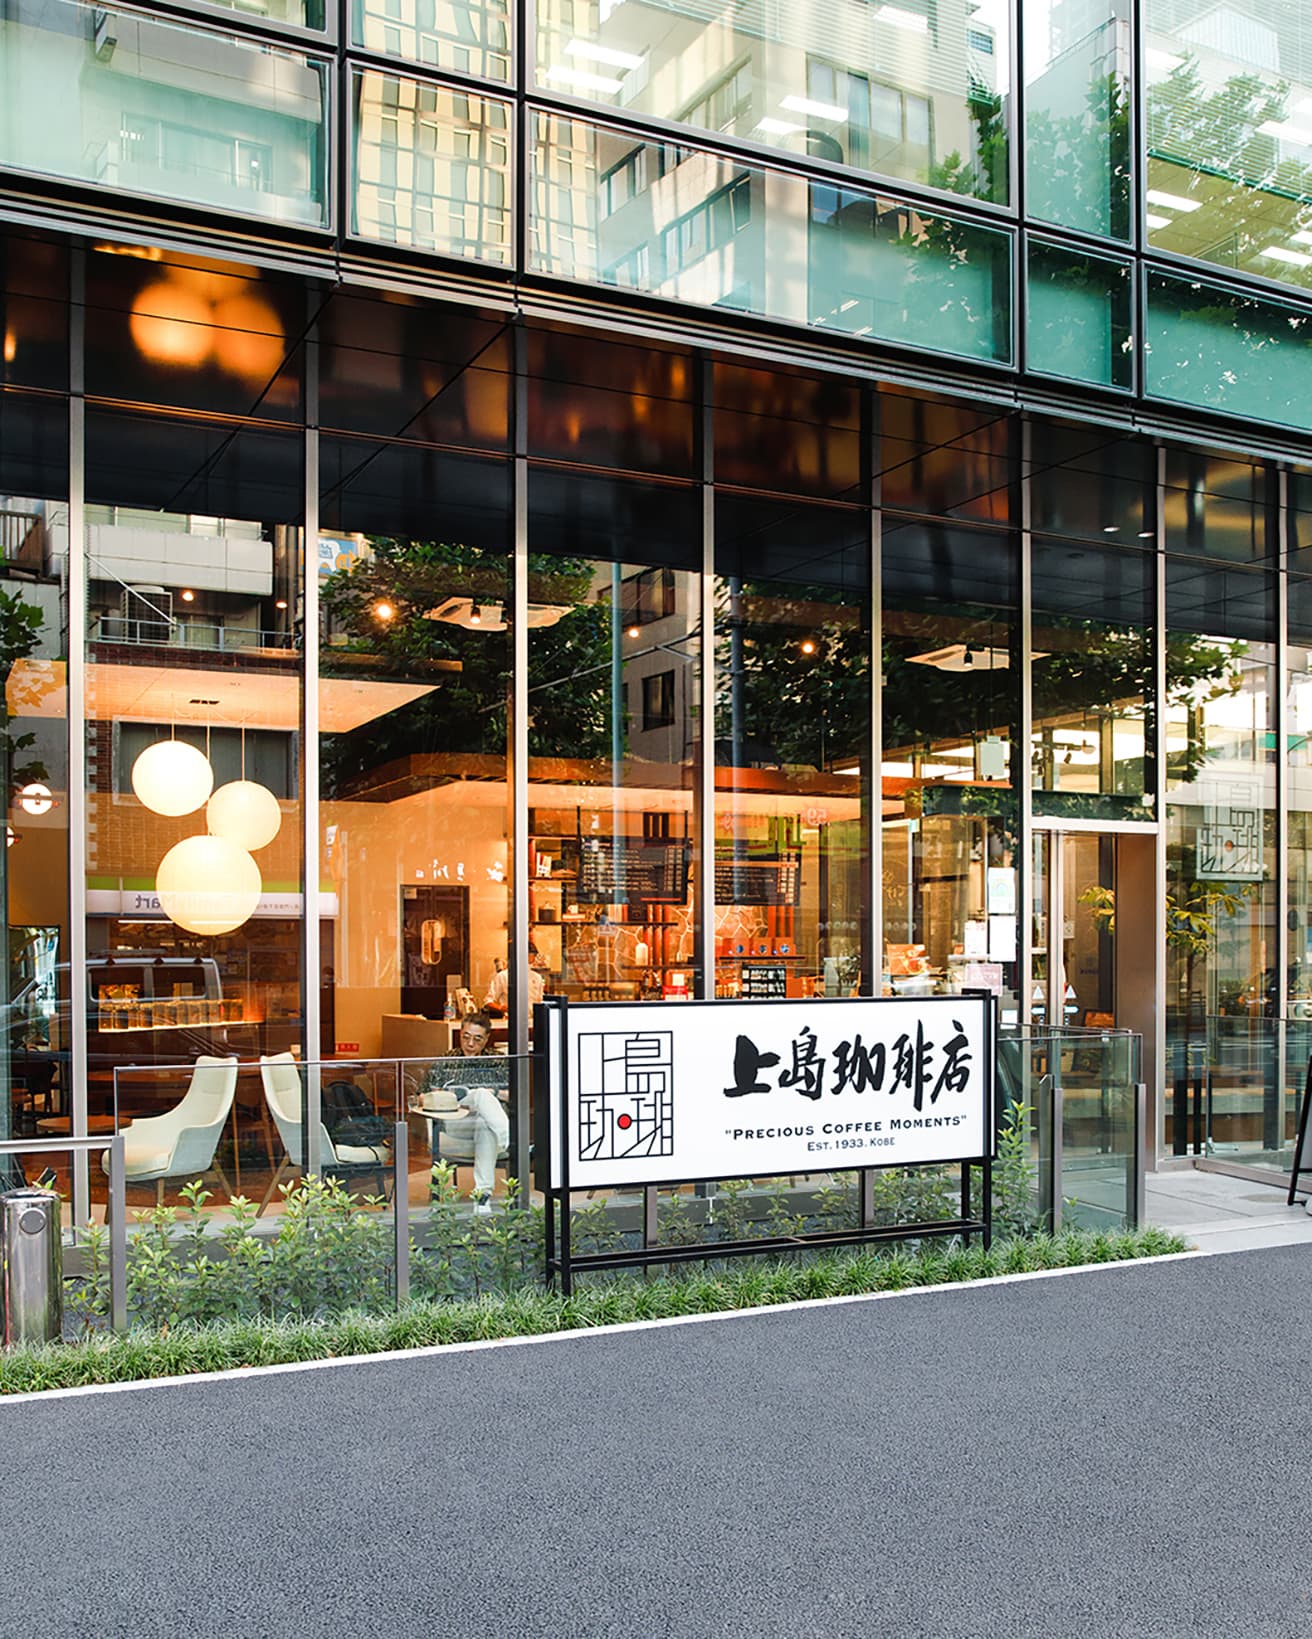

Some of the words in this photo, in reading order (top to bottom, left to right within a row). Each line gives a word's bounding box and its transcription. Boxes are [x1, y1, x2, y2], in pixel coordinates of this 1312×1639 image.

[723, 1018, 973, 1112] 上島珈琲店
[822, 1121, 882, 1135] COFFEE
